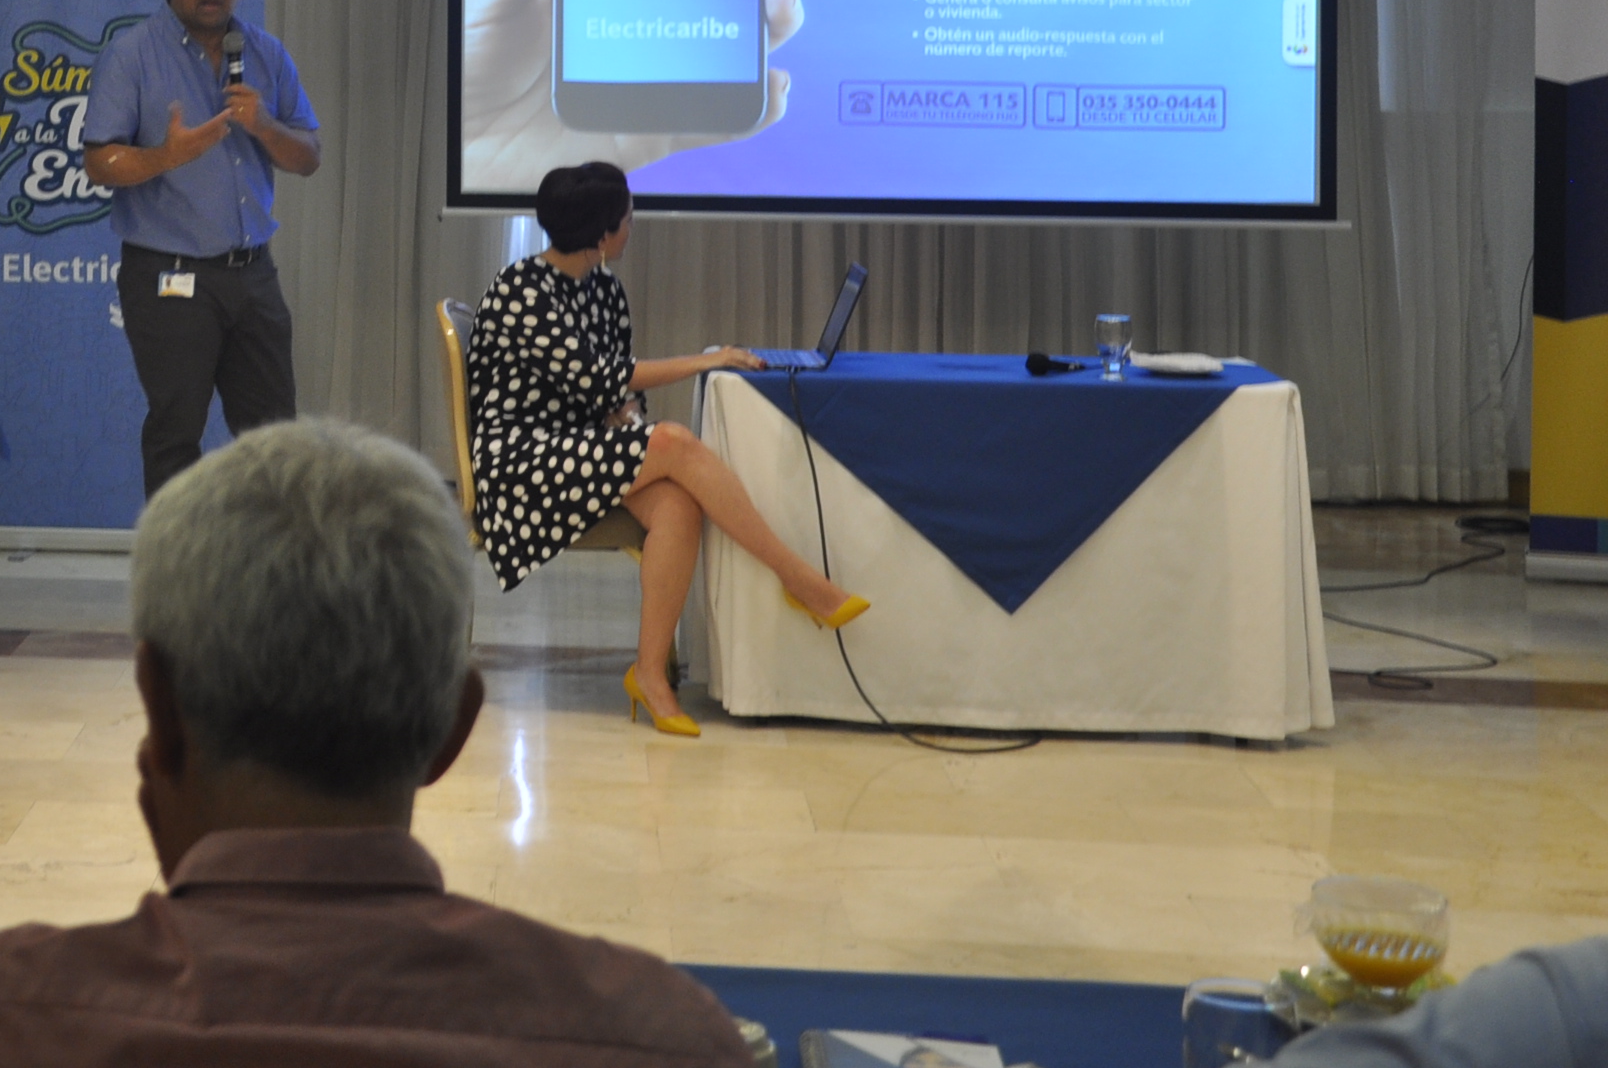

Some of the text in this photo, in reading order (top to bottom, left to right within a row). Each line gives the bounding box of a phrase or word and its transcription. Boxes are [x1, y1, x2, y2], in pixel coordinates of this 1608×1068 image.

[924, 4, 1002, 20] o vivienda.
[586, 17, 739, 40] Electricaribe
[925, 26, 1165, 46] Obtén un audio-respuesta con el
[924, 42, 1067, 60] número de reporte.
[887, 91, 1019, 109] MARCA 115
[1082, 95, 1117, 110] 035
[14, 122, 57, 143] a la
